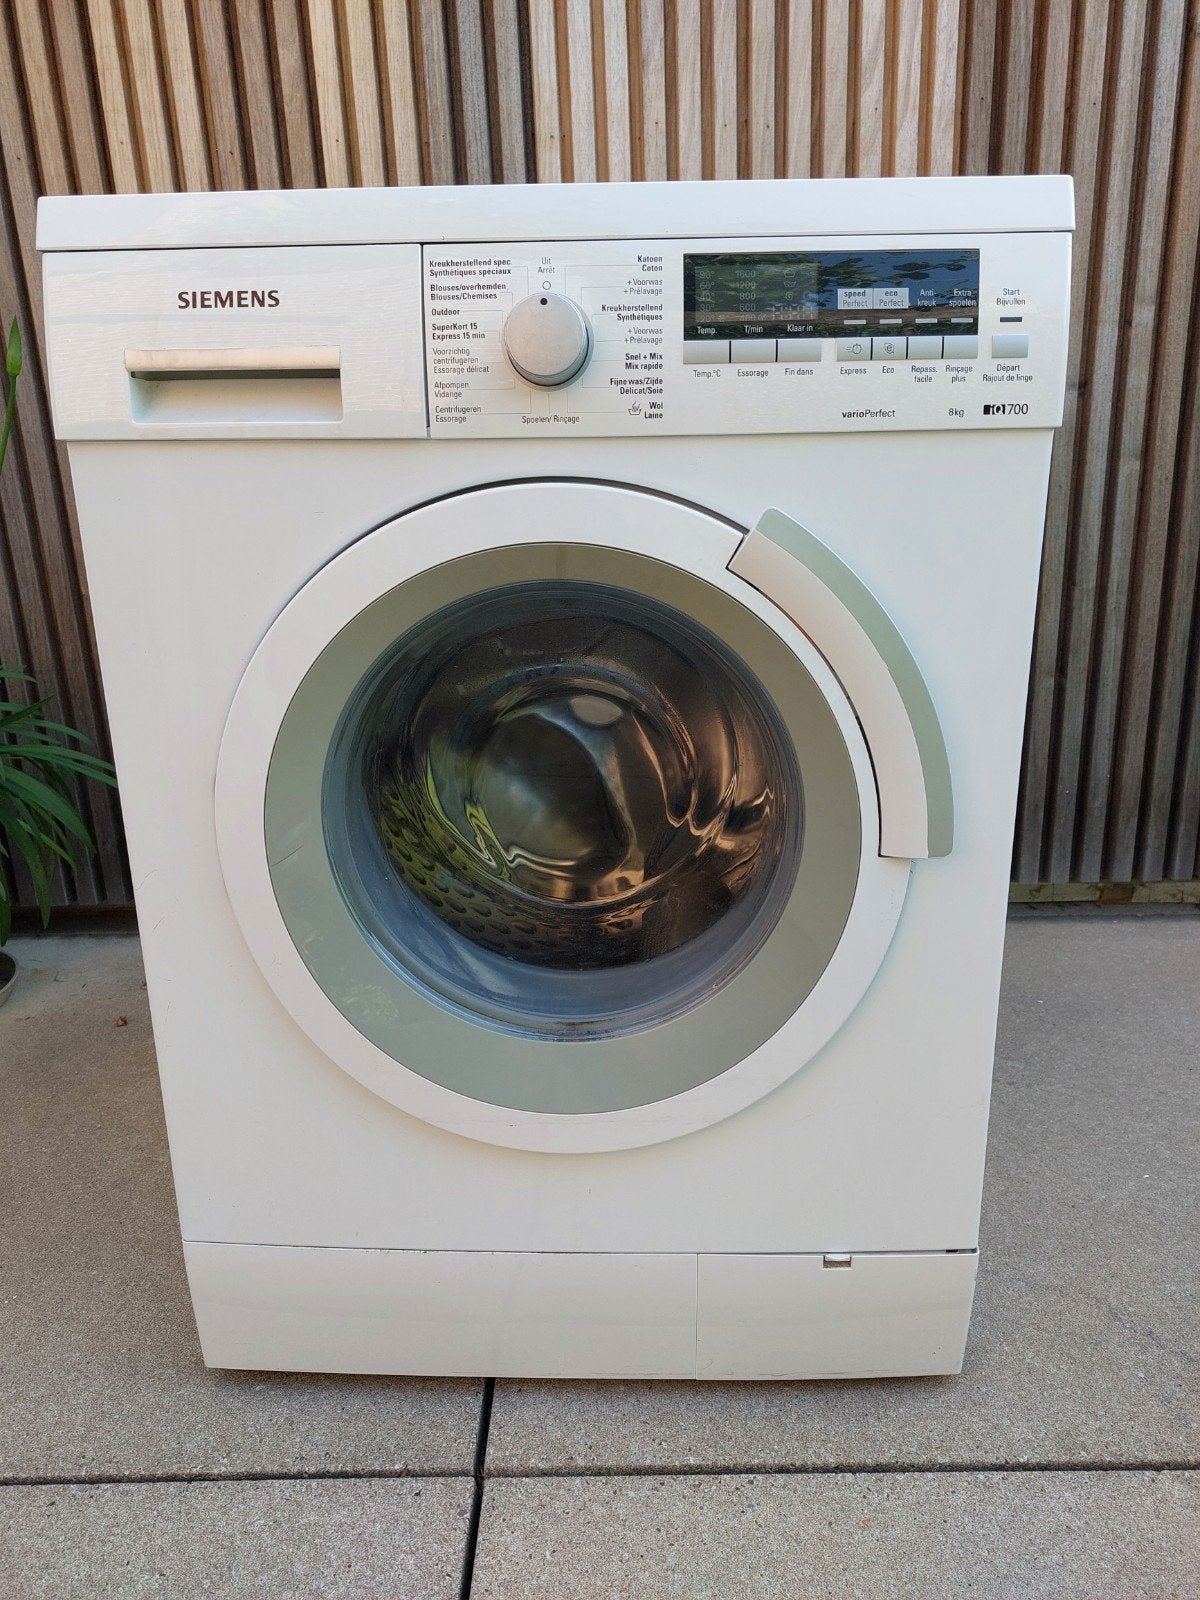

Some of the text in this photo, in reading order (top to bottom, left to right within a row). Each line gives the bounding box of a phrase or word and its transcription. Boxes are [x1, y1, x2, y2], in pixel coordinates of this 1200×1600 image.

[430, 258, 512, 267] Kreukherstellend spec.
[430, 268, 512, 278] Synthétiques spéciaux
[538, 265, 556, 274] Arrêt
[430, 283, 506, 292] Blouses/overhemden
[430, 292, 498, 300] Blouses/Chemises
[844, 290, 866, 298] speed
[178, 290, 280, 309] SIEMENS
[949, 298, 976, 307] spoelen
[996, 298, 1026, 306] Bijvullen
[432, 308, 460, 316] Outdoor
[602, 304, 662, 312] Kreukherstellend
[616, 313, 663, 322] Synthétiques
[432, 323, 468, 332] SuperKort
[697, 326, 718, 334] Temp.
[744, 325, 763, 334] T/min
[432, 332, 460, 342] Express
[432, 348, 470, 356] Voorzichtig
[434, 356, 478, 365] centrifugeren
[434, 366, 464, 374] Essorage
[641, 362, 663, 371] rapide
[840, 366, 867, 375] Express
[911, 365, 938, 374] Repass.
[946, 365, 973, 374] Rinçage
[996, 364, 1020, 372] Départ
[737, 368, 769, 378] Essorage
[784, 367, 814, 376] Fin dans
[610, 377, 663, 387] Fijne was/Zijde
[951, 375, 966, 383] plus
[434, 381, 470, 390] Afpompen
[620, 386, 663, 394] Délicat/Soie
[434, 390, 462, 398] Vidange
[435, 406, 482, 414] Centrifugeren
[842, 409, 896, 418] varioPerfect
[435, 415, 467, 423] Essorage
[522, 415, 580, 424] Spoelen/ Rinçage
